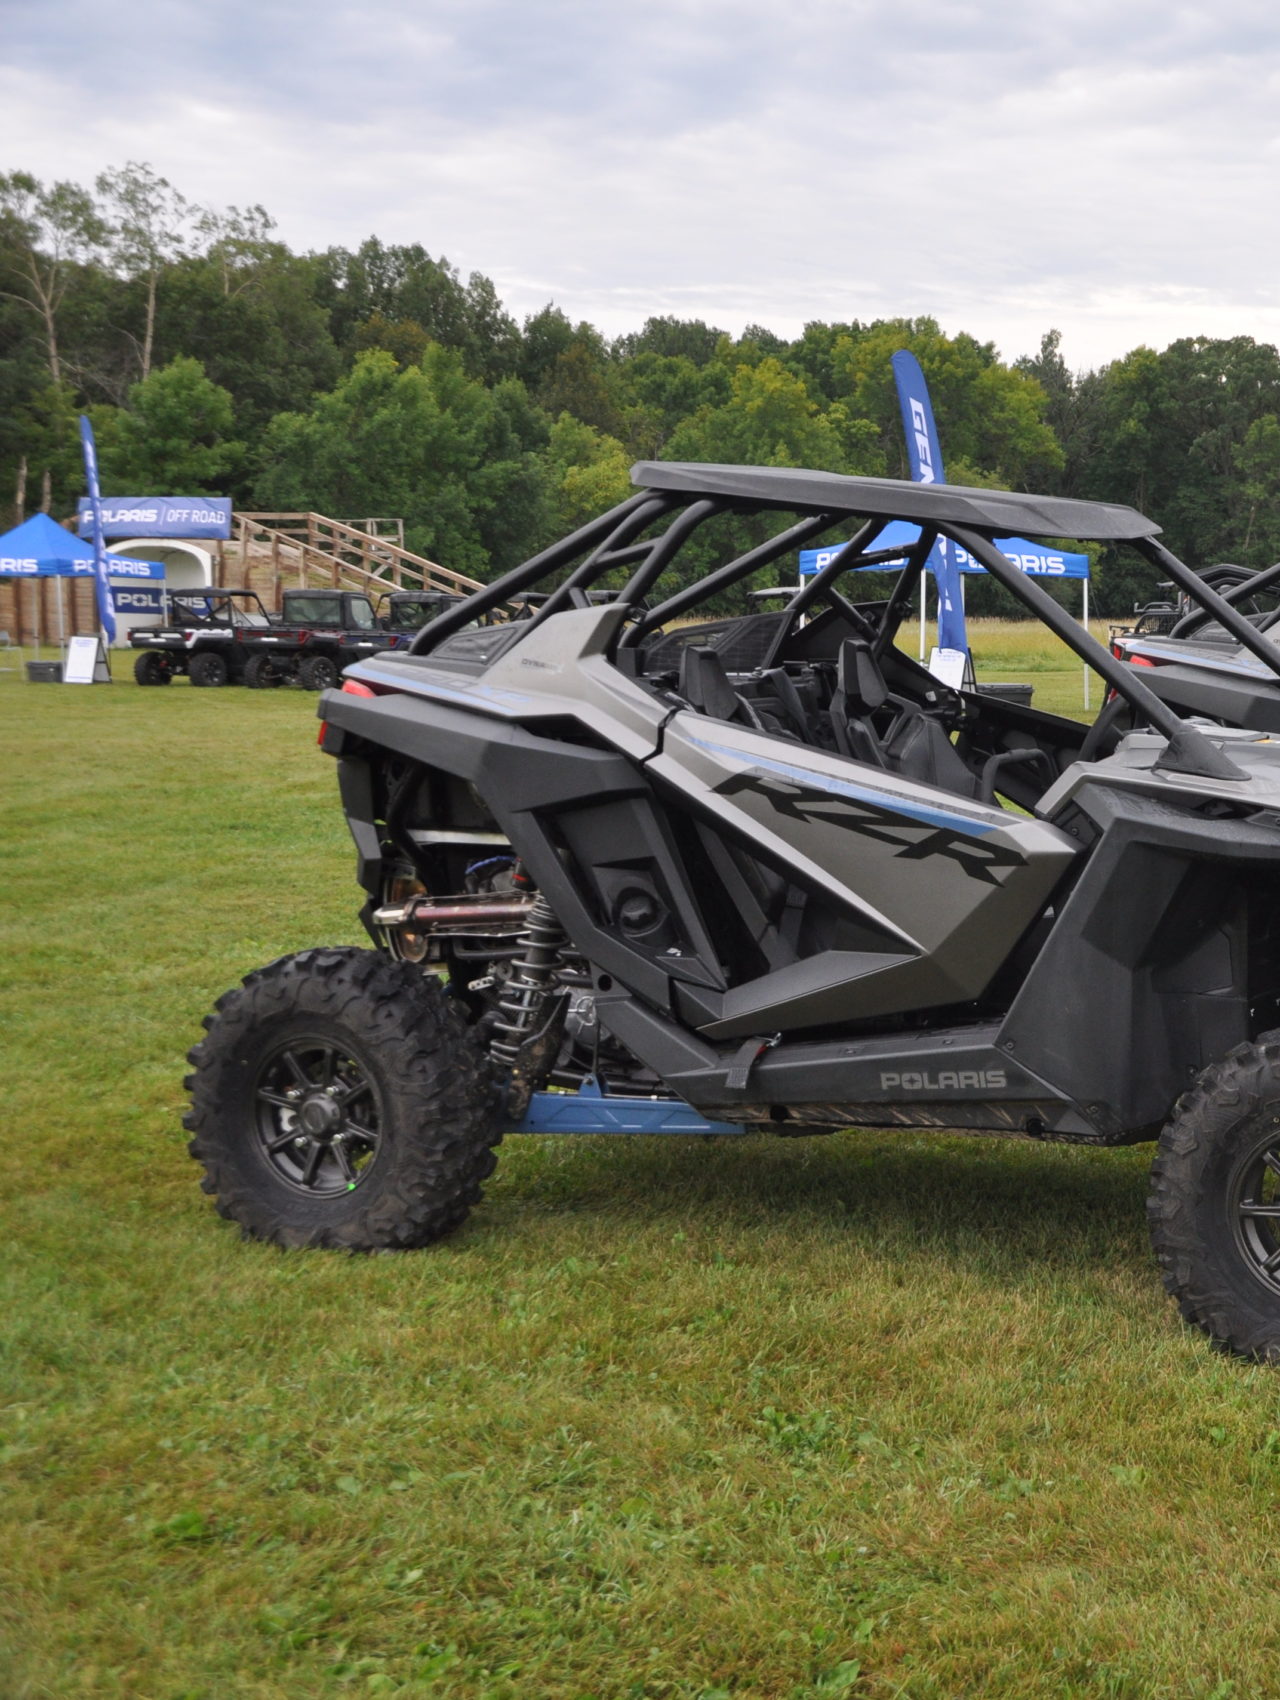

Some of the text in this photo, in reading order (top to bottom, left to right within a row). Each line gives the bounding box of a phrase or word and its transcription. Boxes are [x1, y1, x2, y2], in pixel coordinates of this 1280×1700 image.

[167, 509, 190, 522] OFF
[191, 510, 226, 524] ROAD
[706, 768, 1030, 888] RZR
[880, 1070, 1007, 1090] POLARIS
